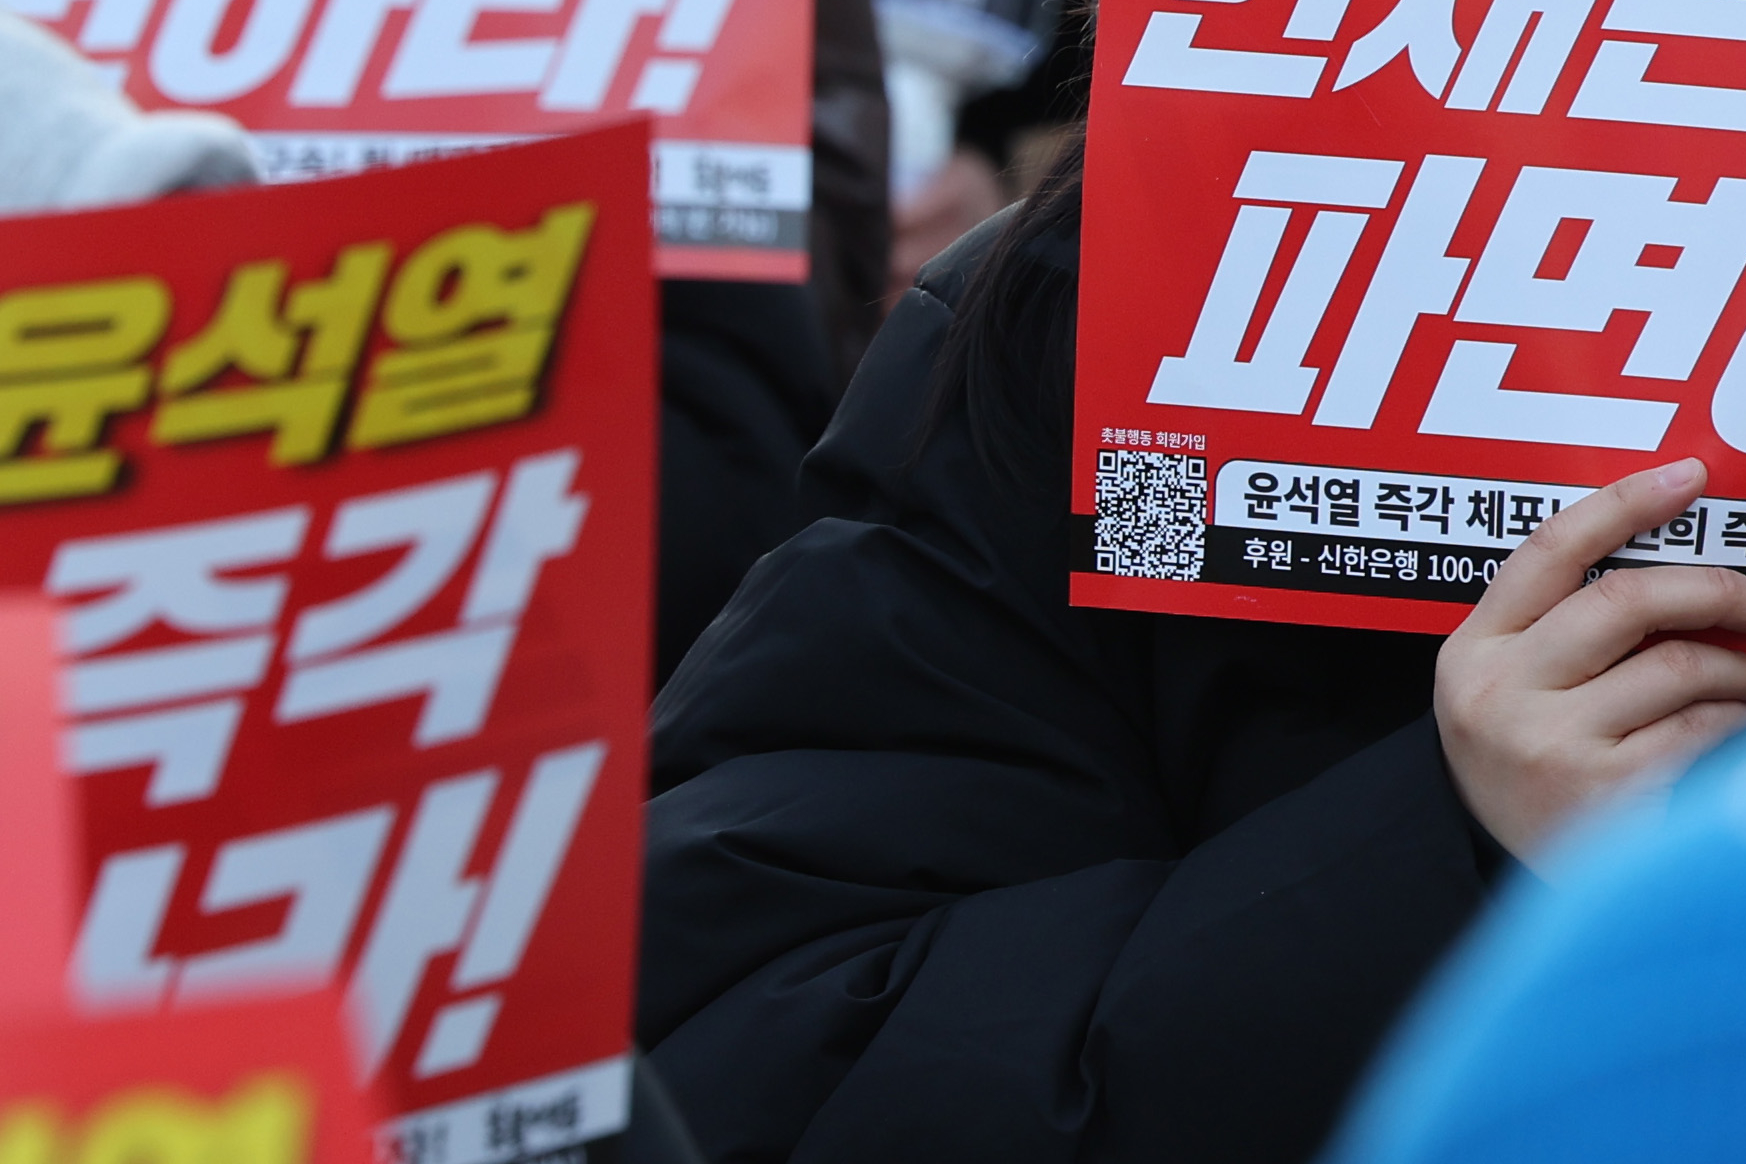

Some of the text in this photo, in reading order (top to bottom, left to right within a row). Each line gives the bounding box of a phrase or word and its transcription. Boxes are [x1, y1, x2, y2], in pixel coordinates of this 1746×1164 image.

[1155, 431, 1206, 451] 회원가입
[1243, 472, 1361, 528] 윤석열
[1373, 483, 1455, 536] 즉각
[1242, 538, 1293, 572] 후원
[1317, 544, 1419, 581] 신한은행
[46, 448, 591, 807] 즉각
